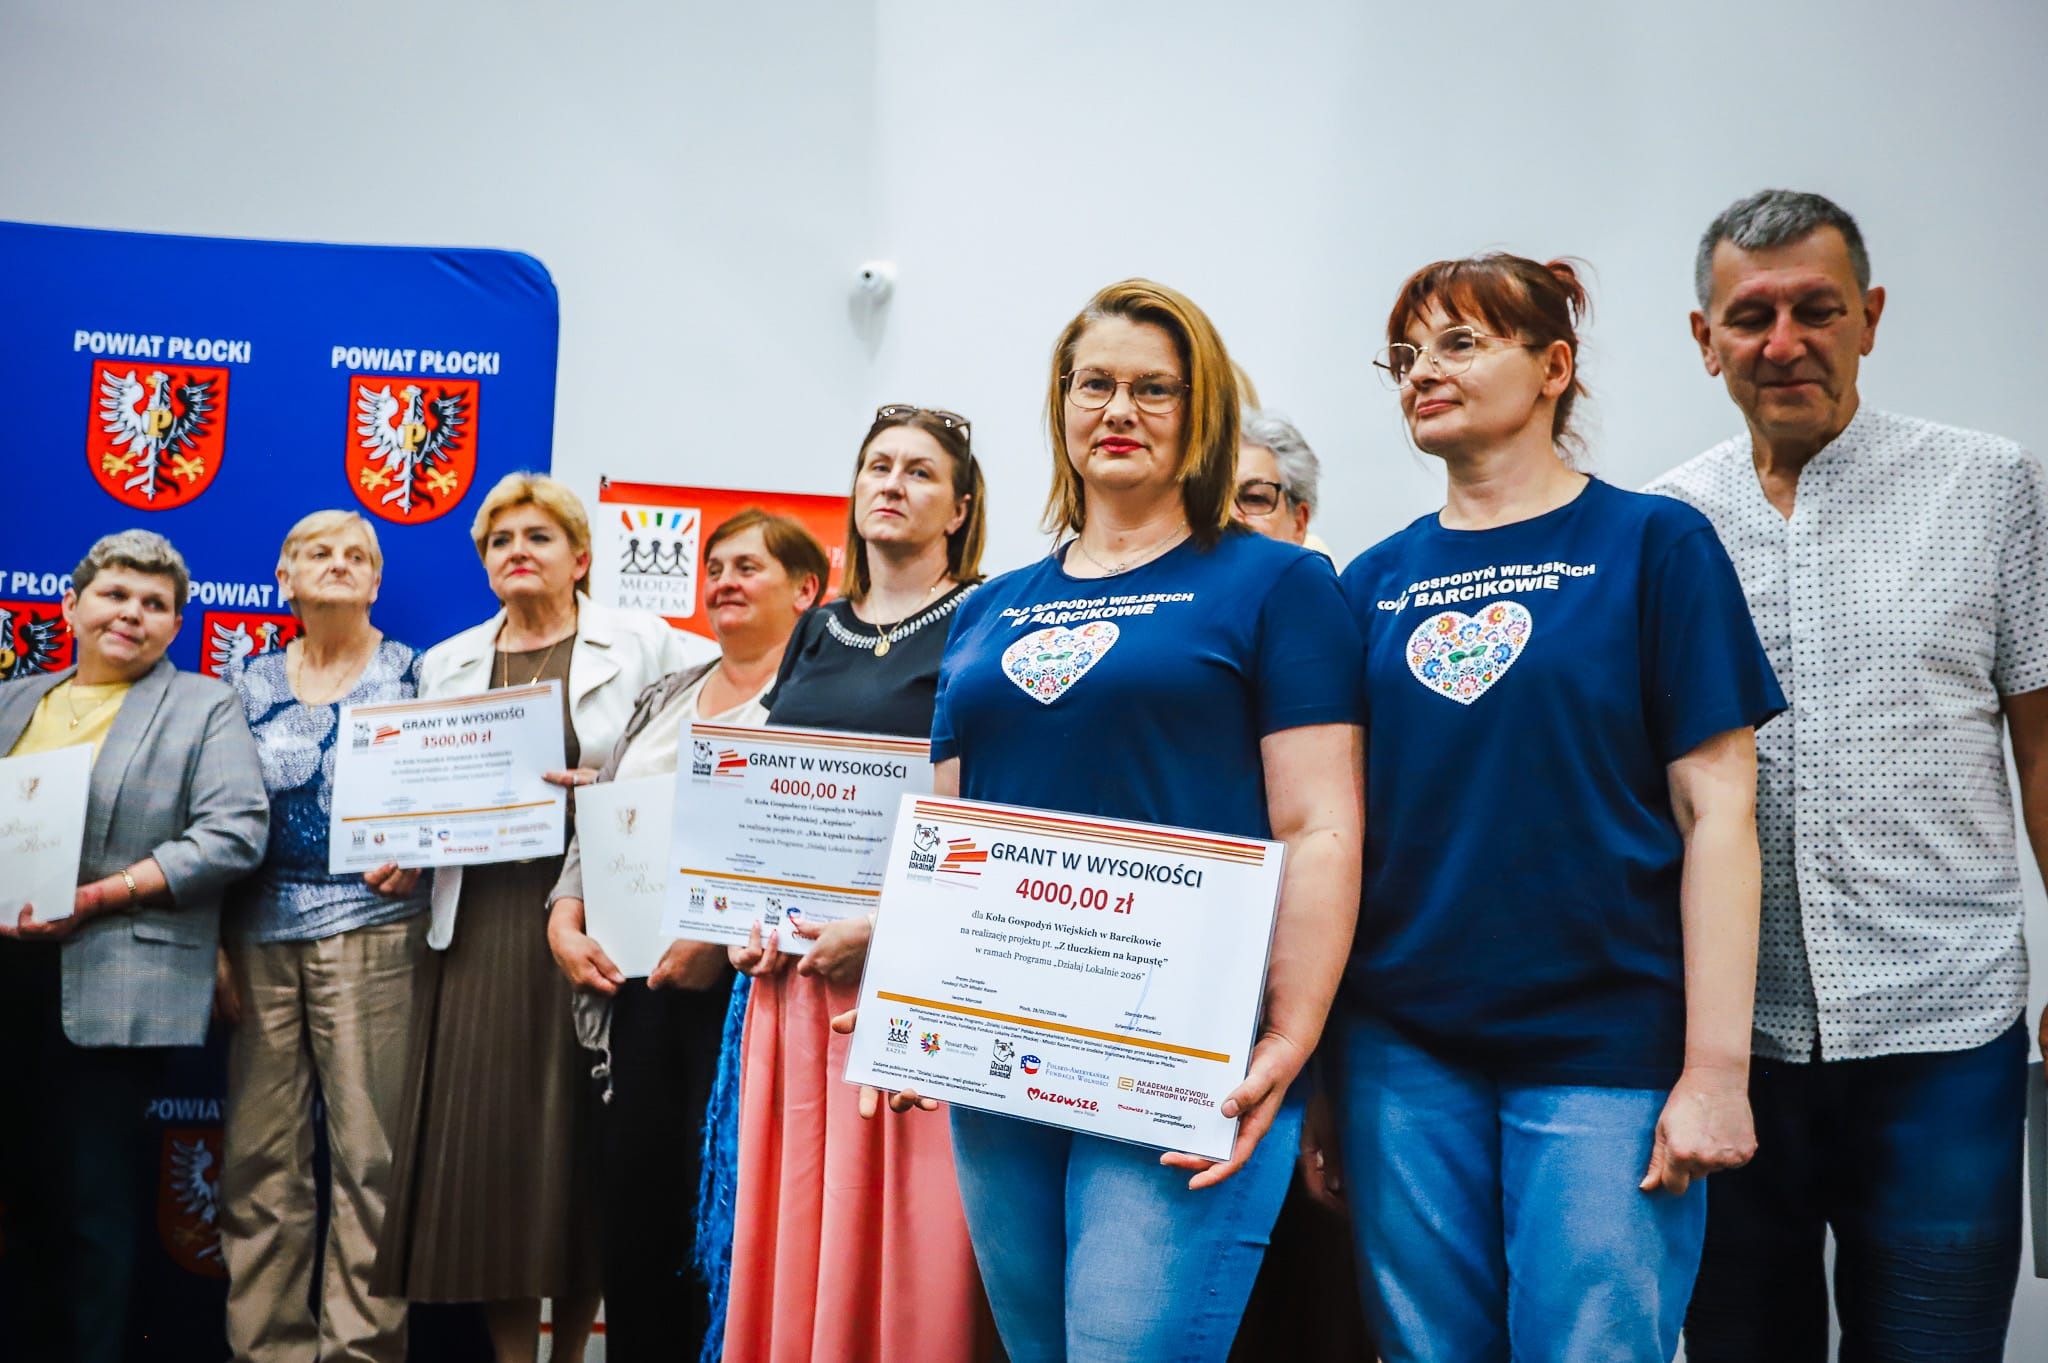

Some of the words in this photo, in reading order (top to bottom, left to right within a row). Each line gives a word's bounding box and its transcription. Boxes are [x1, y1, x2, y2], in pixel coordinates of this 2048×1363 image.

[73, 329, 165, 358] POWIAT
[168, 336, 252, 363] PŁOCKI
[331, 345, 416, 372] POWIAT
[420, 350, 500, 375] PŁOCKI
[11, 570, 73, 596] PŁOC
[1408, 566, 1496, 594] GOSPODYŃ
[1500, 561, 1596, 578] WIEJSKICH
[1414, 574, 1559, 608] BARCIKOWIE
[188, 582, 273, 608] POWIAT
[1109, 592, 1194, 606] WIEJSKICH
[402, 718, 441, 731] GRANT
[446, 717, 458, 727] W
[461, 707, 525, 724] WYSOKOŚCI
[481, 730, 492, 744] zł
[750, 752, 797, 770] GRANT
[800, 756, 815, 771] W
[818, 759, 907, 779] WYSOKOŚCI
[770, 778, 837, 800] 4000,00
[842, 784, 857, 801] zł
[991, 842, 1057, 867] GRANT
[1062, 851, 1082, 870] W
[1087, 855, 1203, 888] WYSOKOŚCI
[1016, 878, 1108, 911] 4000,00
[1114, 892, 1135, 914] zł
[971, 910, 984, 920] dla
[1008, 916, 1052, 931] Gospodyń
[1054, 923, 1098, 938] Wiejskich
[1109, 932, 1162, 948] Barcikowie
[960, 927, 970, 935] na
[971, 928, 1007, 943] realizację
[1008, 935, 1041, 947] projektu
[1042, 941, 1052, 950] pt.
[1067, 943, 1111, 958] tłuczkiem
[1112, 951, 1124, 960] na
[983, 948, 1012, 959] ramach
[1014, 952, 1052, 966] Programu
[1085, 964, 1119, 977] Lokalnie
[1136, 1087, 1178, 1100] FILANTROPII
[1188, 1097, 1215, 1108] POLSCE
[1137, 1080, 1173, 1092] AKADEMIA
[1174, 1087, 1209, 1099] ROZWOJU
